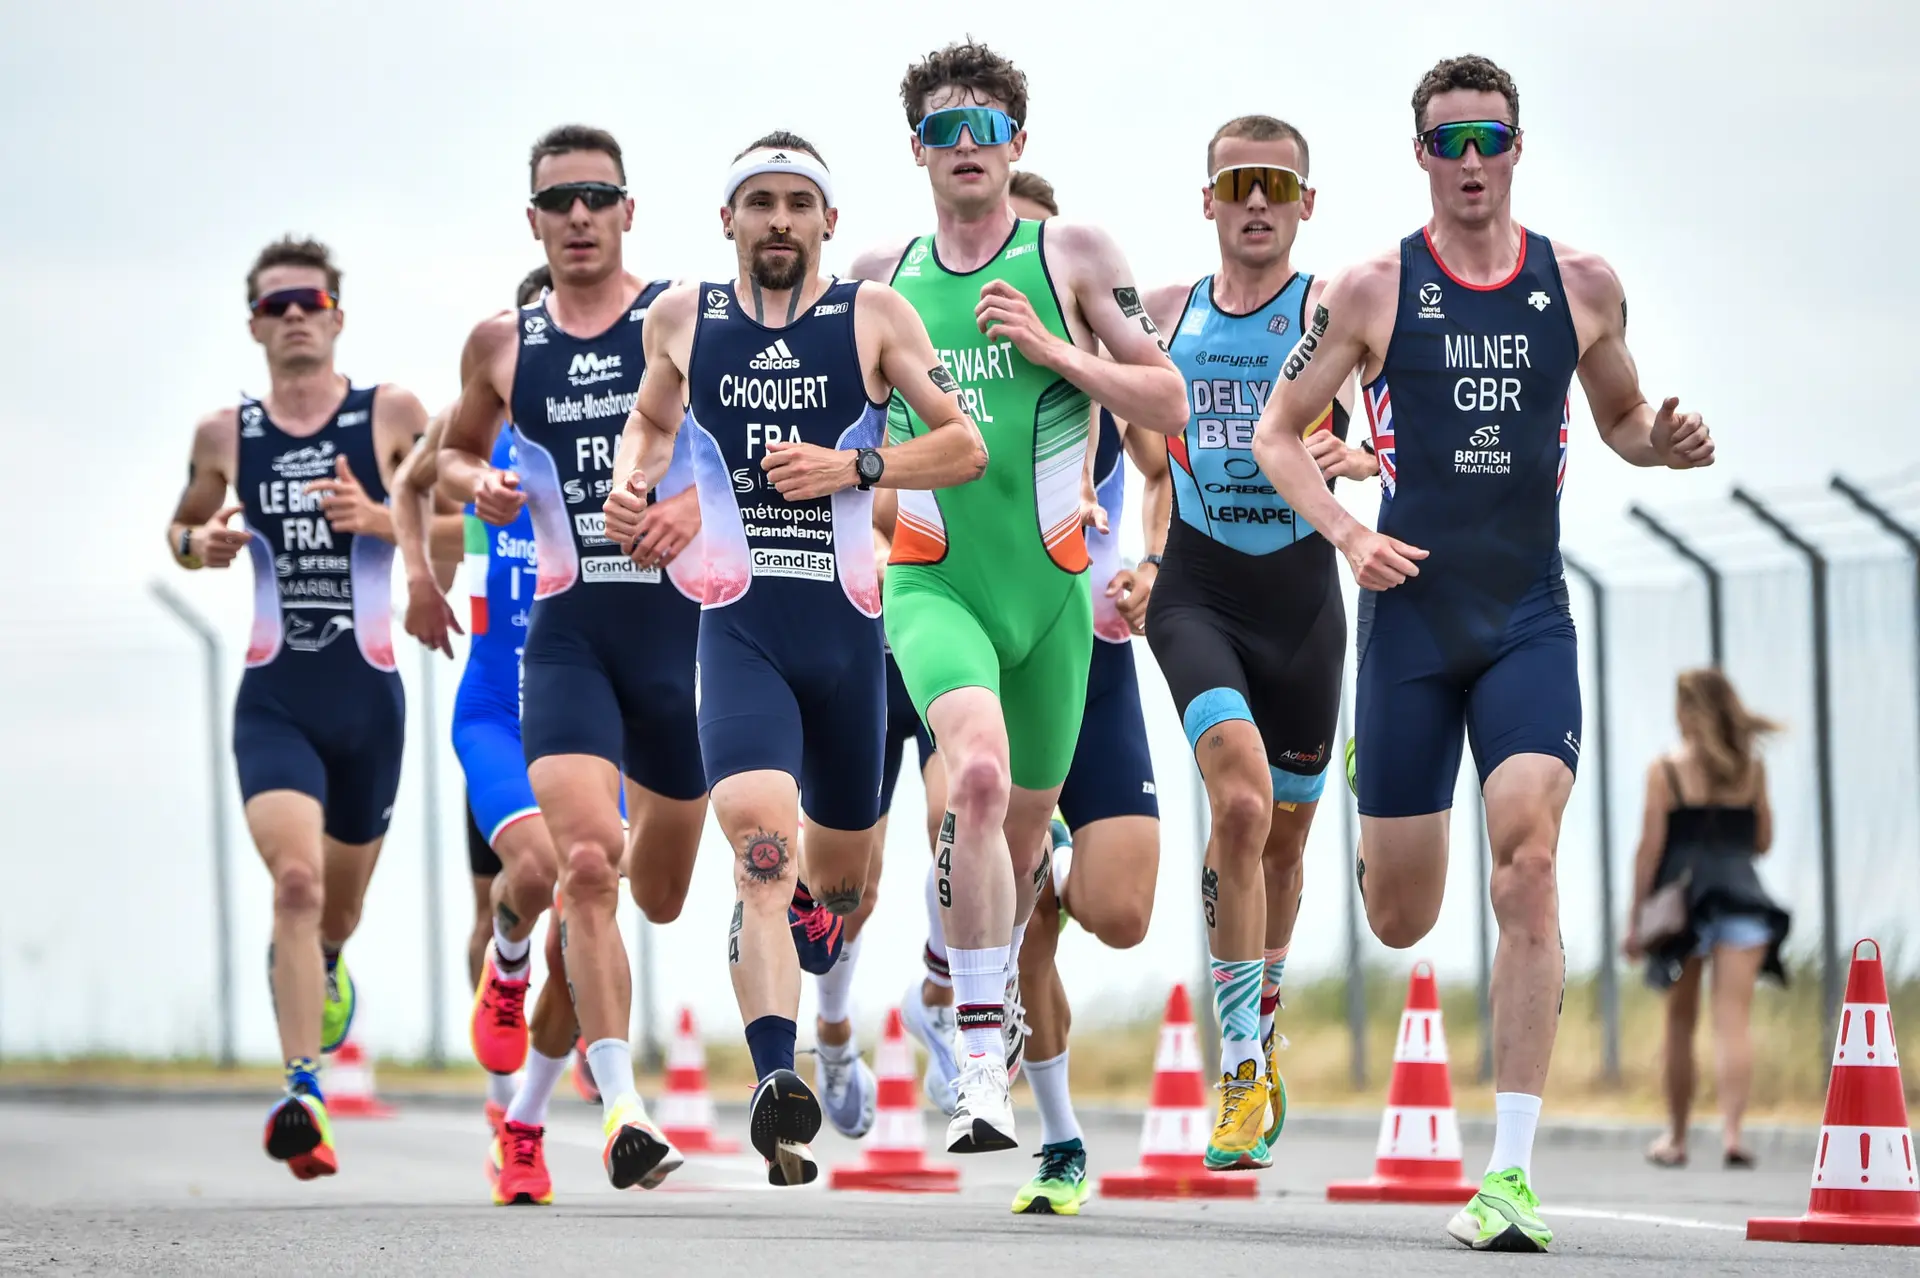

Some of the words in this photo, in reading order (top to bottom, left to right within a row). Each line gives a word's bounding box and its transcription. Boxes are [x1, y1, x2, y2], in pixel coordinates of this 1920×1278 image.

[1422, 306, 1441, 314] World
[934, 341, 1014, 383] EWART
[1445, 334, 1531, 369] MILNER
[568, 352, 622, 376] Metz
[749, 357, 800, 370] adidas
[567, 370, 623, 387] Triathlon
[719, 374, 828, 413] CHOQUERT
[1192, 379, 1270, 415] DELY
[1454, 377, 1522, 412] GBR
[1197, 419, 1260, 450] BE
[1455, 450, 1511, 464] BRITISH
[1455, 463, 1511, 474] TRIATHLON
[260, 482, 286, 514] LE
[1205, 483, 1278, 494] ORBE
[740, 503, 832, 525] métropole
[1208, 505, 1292, 525] LEPAPE
[282, 517, 334, 551] FRA
[744, 524, 833, 546] GrandNancy
[585, 559, 632, 573] Grand
[754, 551, 805, 567] Grand
[938, 847, 952, 908] 49
